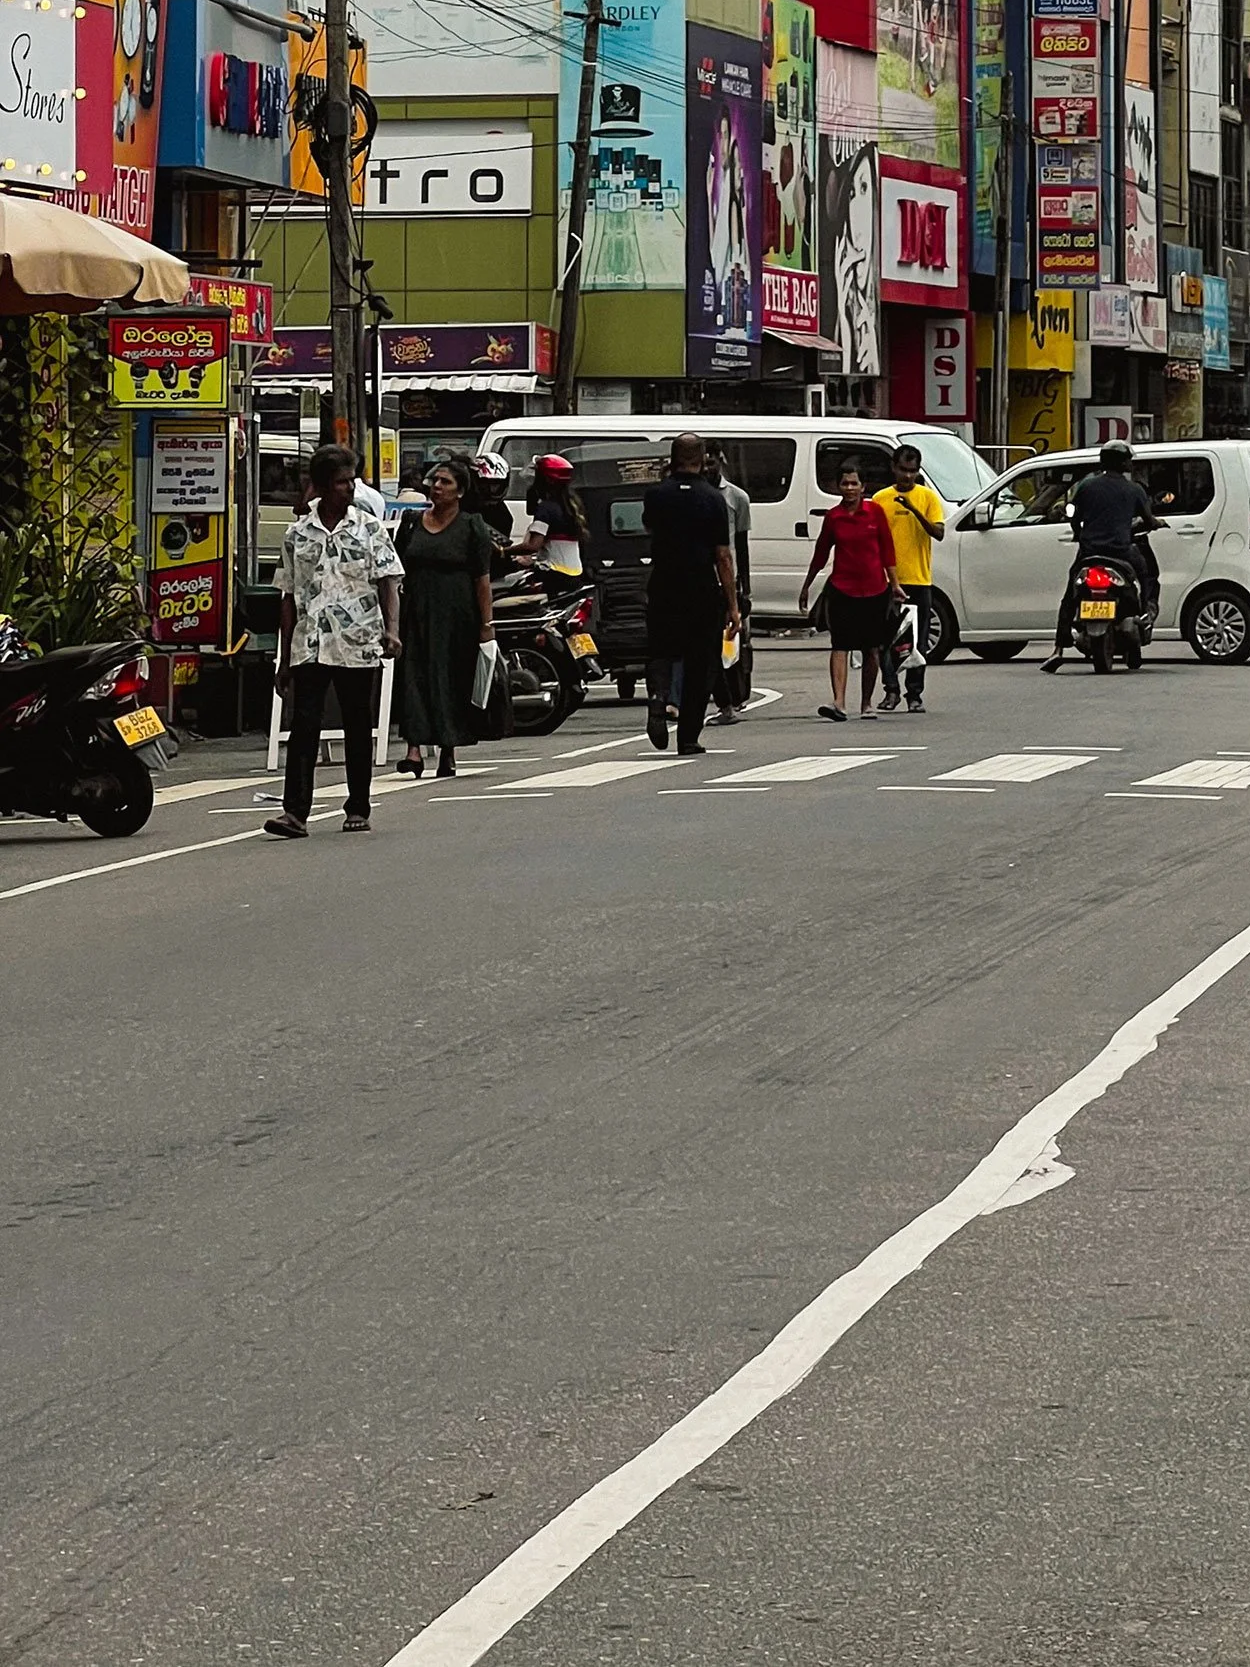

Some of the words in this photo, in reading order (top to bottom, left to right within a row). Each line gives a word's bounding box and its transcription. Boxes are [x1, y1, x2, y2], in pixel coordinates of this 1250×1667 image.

[602, 6, 660, 20] RDLEY
[0, 33, 65, 124] Stores
[370, 160, 504, 204] tro
[762, 272, 789, 314] THE
[792, 277, 817, 318] BAG
[122, 324, 214, 348] ඔරලෝසු
[932, 327, 961, 408] DSI
[159, 590, 213, 619] බැටරි
